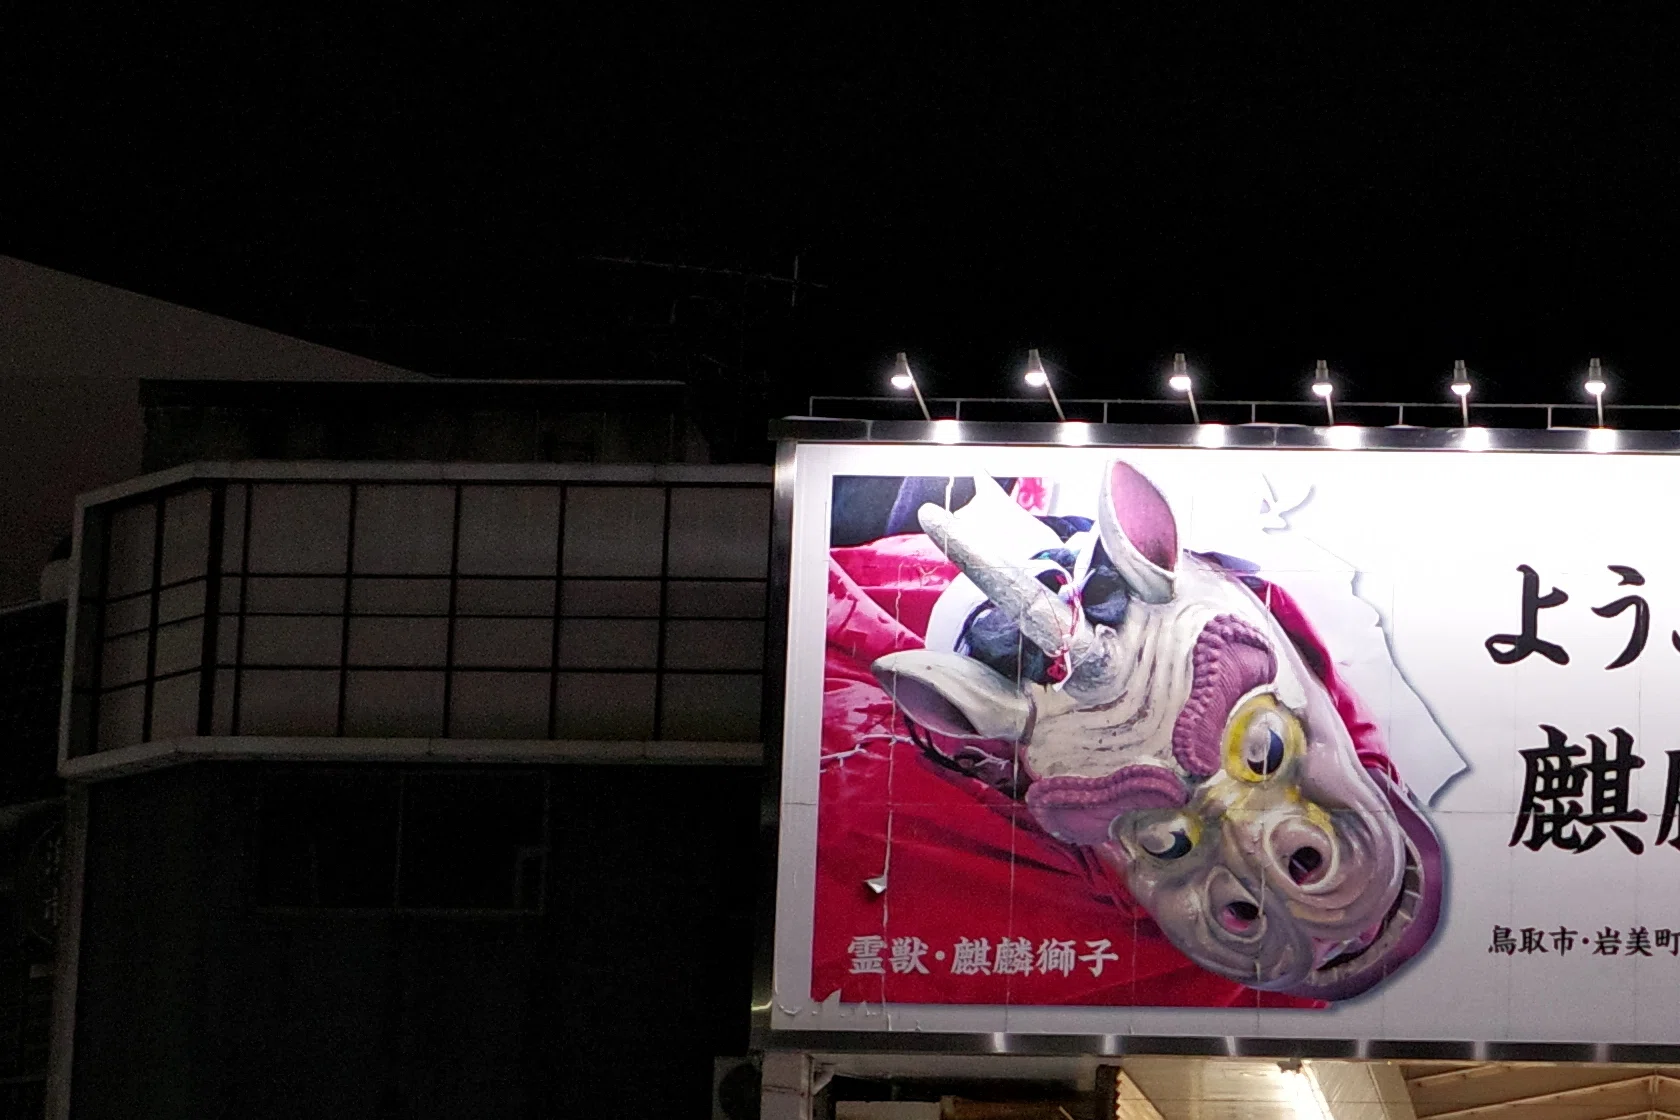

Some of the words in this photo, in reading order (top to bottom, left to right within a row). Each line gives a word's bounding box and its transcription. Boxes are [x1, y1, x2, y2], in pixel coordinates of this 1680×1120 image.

[847, 934, 1119, 979] 霊獣・麒麟獅子
